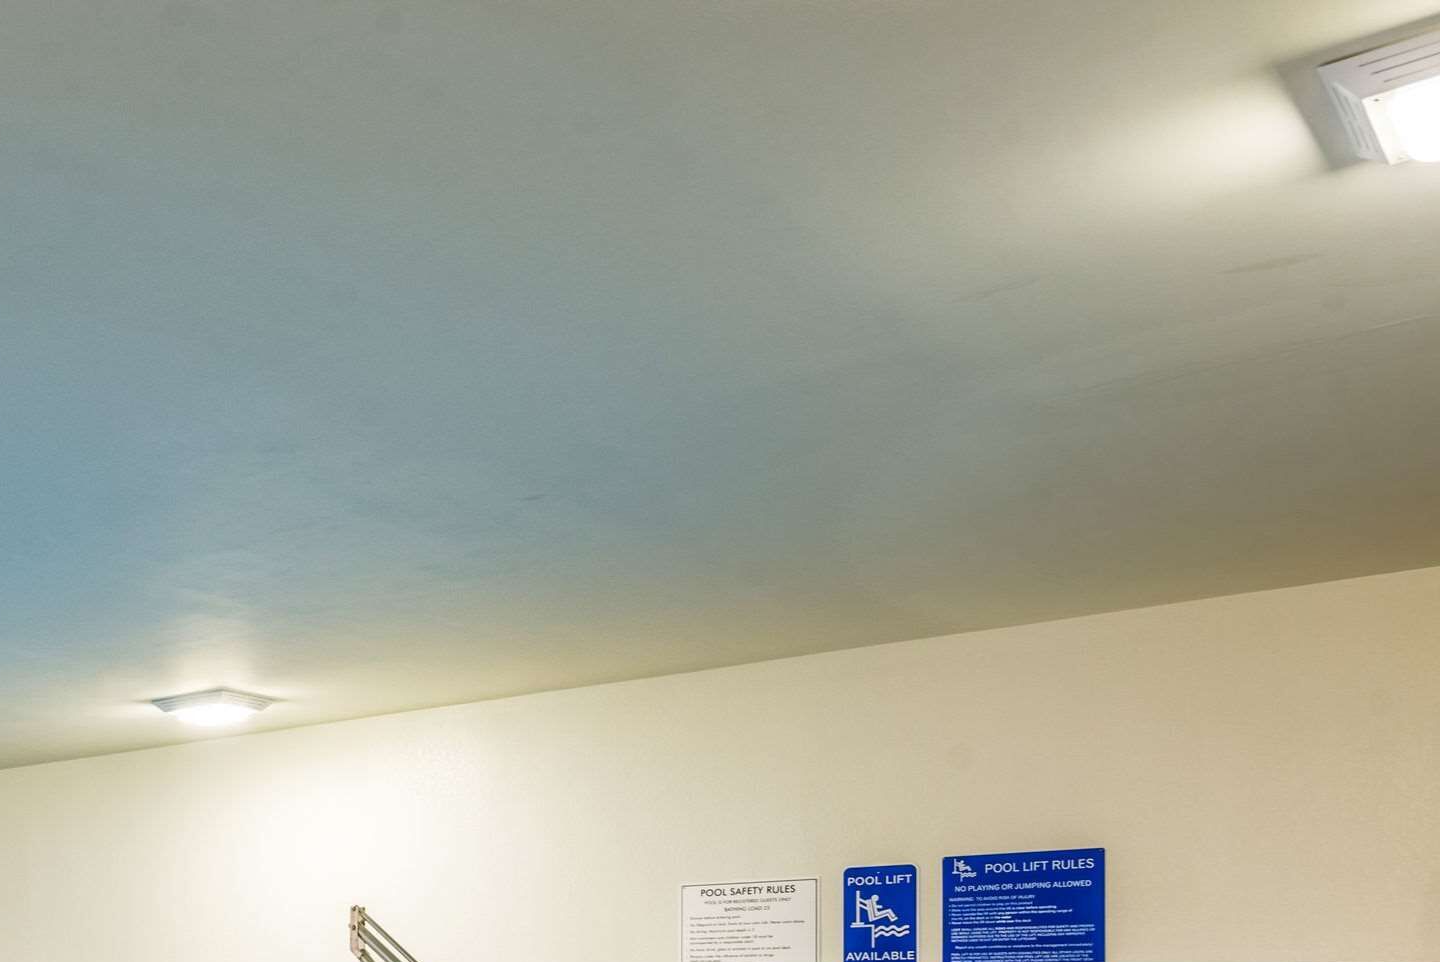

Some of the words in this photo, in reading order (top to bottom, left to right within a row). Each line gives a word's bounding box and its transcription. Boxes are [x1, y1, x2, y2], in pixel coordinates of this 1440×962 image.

[984, 863, 1019, 873] POOL
[1023, 860, 1048, 872] LIFT
[1052, 858, 1095, 870] RULES
[847, 876, 882, 886] POOL
[885, 874, 912, 884] LIFT
[967, 884, 1000, 892] PLAYING
[1014, 881, 1051, 890] JUMPING
[1052, 879, 1092, 888] ALLOWED
[700, 888, 727, 897] POOL
[730, 886, 763, 896] SAFETY
[766, 884, 796, 894] RULES
[846, 951, 915, 961] AVAILABLE
